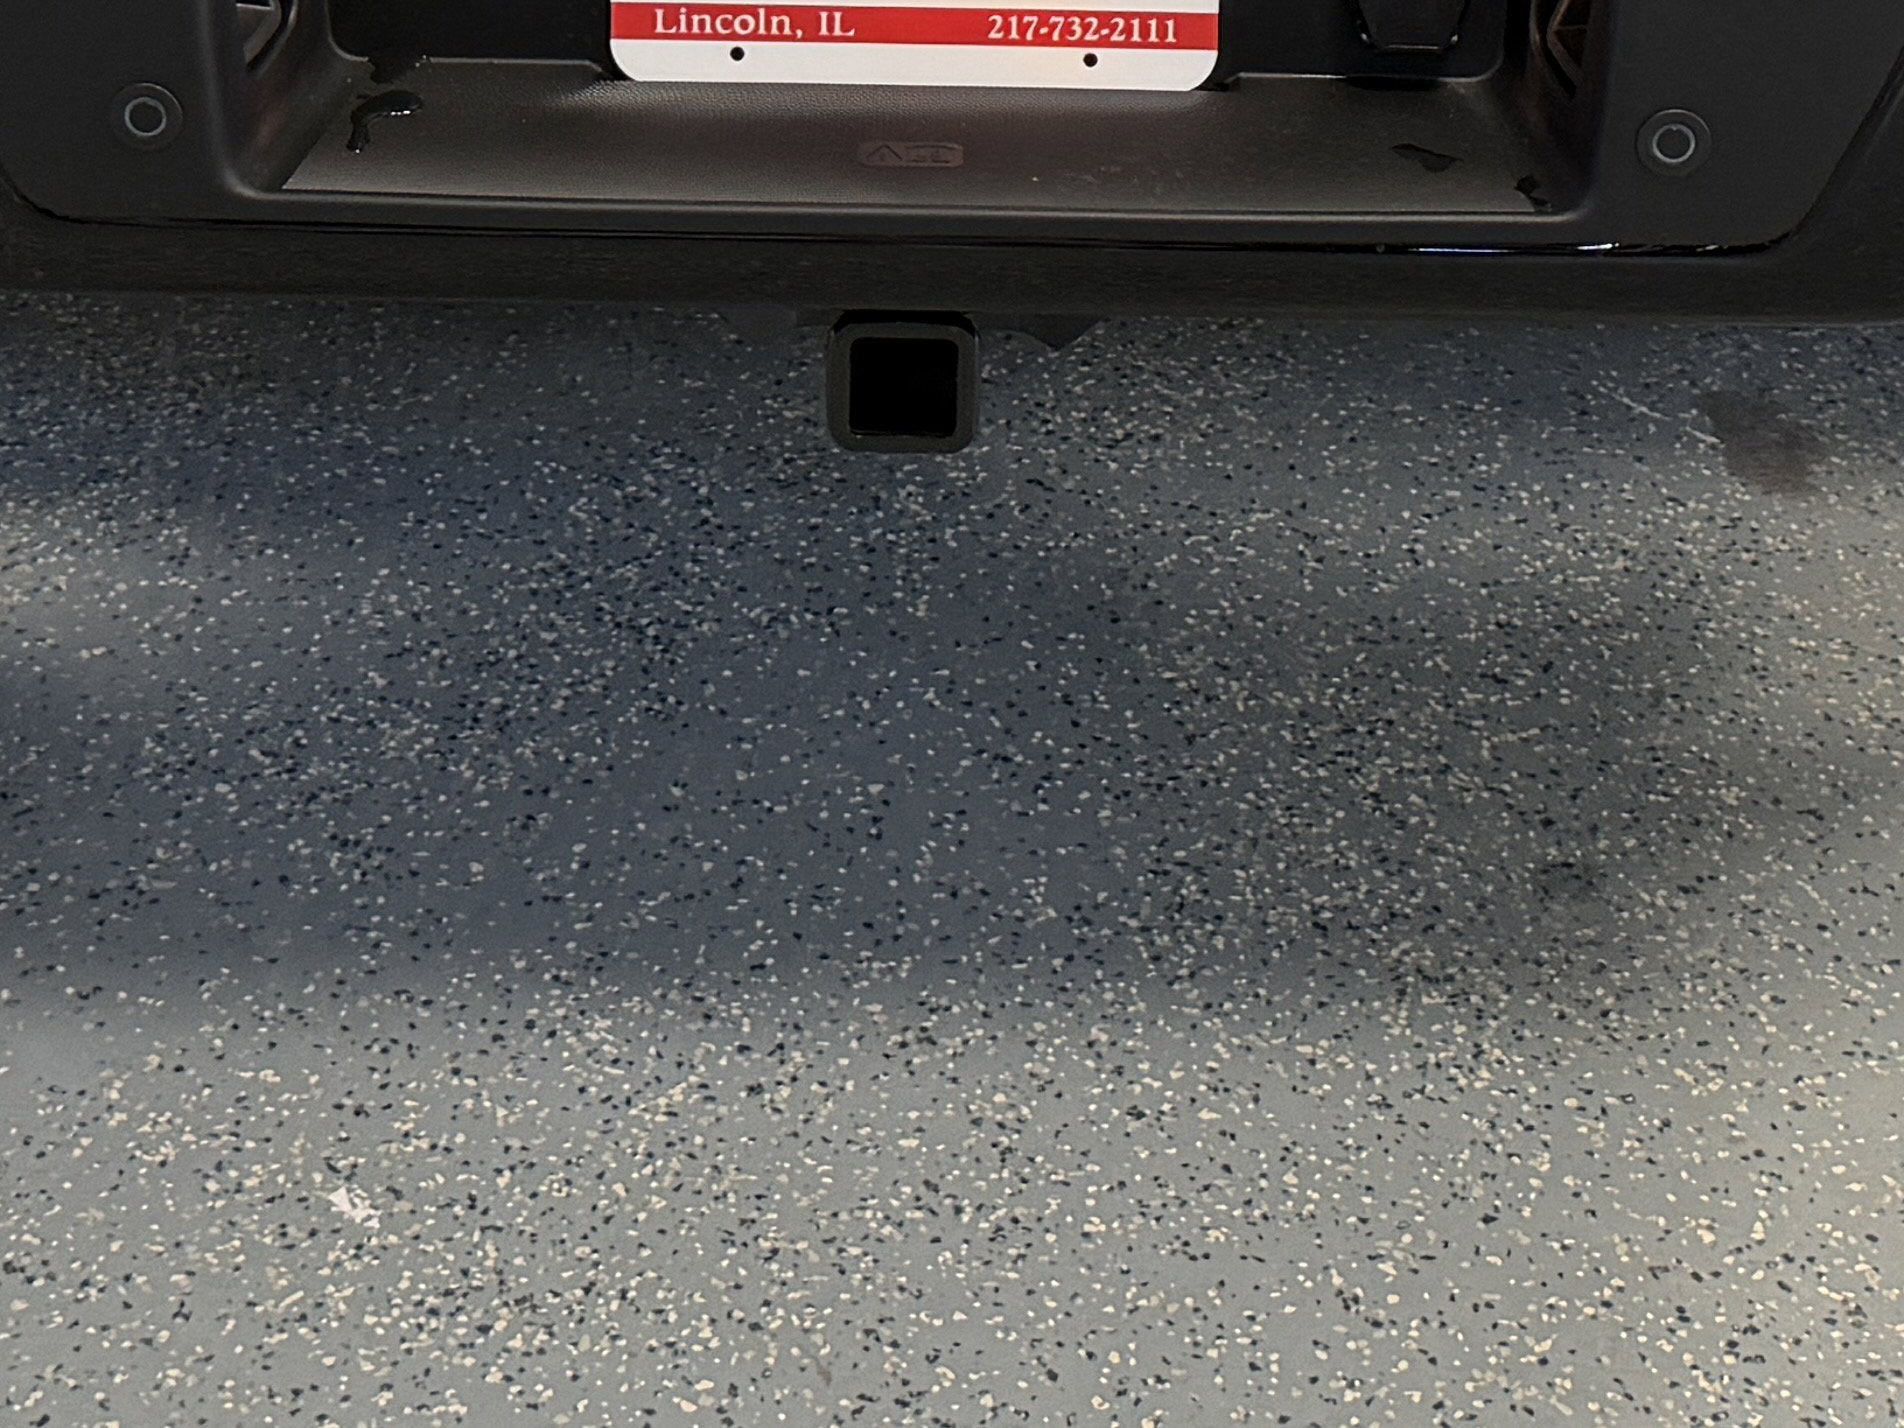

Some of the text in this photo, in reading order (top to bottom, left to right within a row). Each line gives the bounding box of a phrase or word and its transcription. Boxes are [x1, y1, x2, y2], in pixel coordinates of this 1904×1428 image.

[653, 7, 1179, 45] Lincoln, IL 217-732-2111
